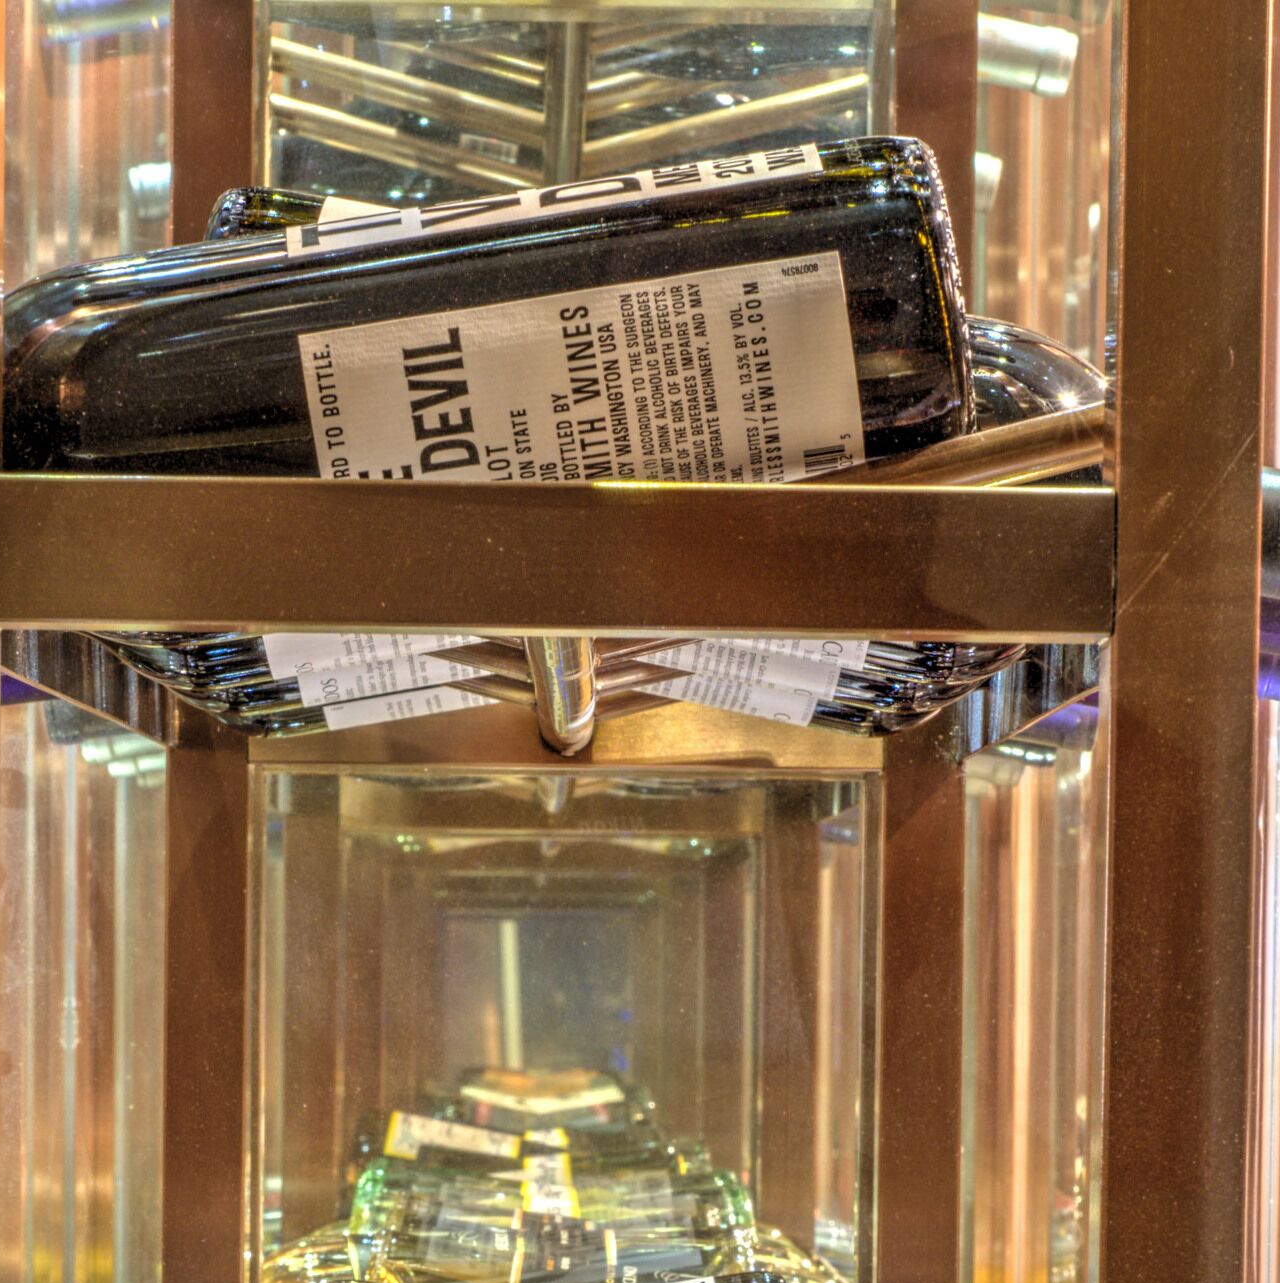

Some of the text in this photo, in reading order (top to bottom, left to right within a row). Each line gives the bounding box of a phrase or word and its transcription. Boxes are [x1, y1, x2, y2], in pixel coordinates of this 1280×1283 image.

[670, 285, 687, 317] YOUR
[687, 283, 703, 308] MAY
[619, 293, 640, 349] SURGEON
[636, 291, 658, 355] BEVERAGES
[653, 286, 673, 338] DEFECTS.
[692, 313, 708, 337] AND
[730, 302, 744, 330] VOL.
[597, 323, 617, 354] USA
[676, 322, 696, 371] IMPAIRS
[733, 334, 748, 349] BY
[559, 305, 602, 405] WINES
[628, 351, 644, 374] THE
[662, 342, 679, 377] BIRTH
[736, 353, 752, 385] 13.5%
[313, 344, 341, 418] BOTTLE.
[632, 377, 646, 393] TO
[647, 359, 668, 419] ALCOHOLIC
[668, 382, 681, 395] OF
[402, 327, 481, 474] DEVIL
[602, 359, 632, 457] WASHINGTON
[670, 399, 685, 423] RISK
[684, 375, 705, 436] BEVERAGES
[742, 388, 756, 412] ALC.
[326, 426, 349, 450] TO
[510, 408, 532, 454] STATE
[546, 394, 581, 480] BOTTLED BY
[635, 396, 656, 456] ACCORDING
[656, 423, 673, 454] DRINK
[674, 427, 689, 445] THE
[707, 417, 725, 459] OPERATE
[677, 448, 690, 459] OF
[746, 426, 764, 465] SULFITES
[661, 457, 676, 475] NOT
